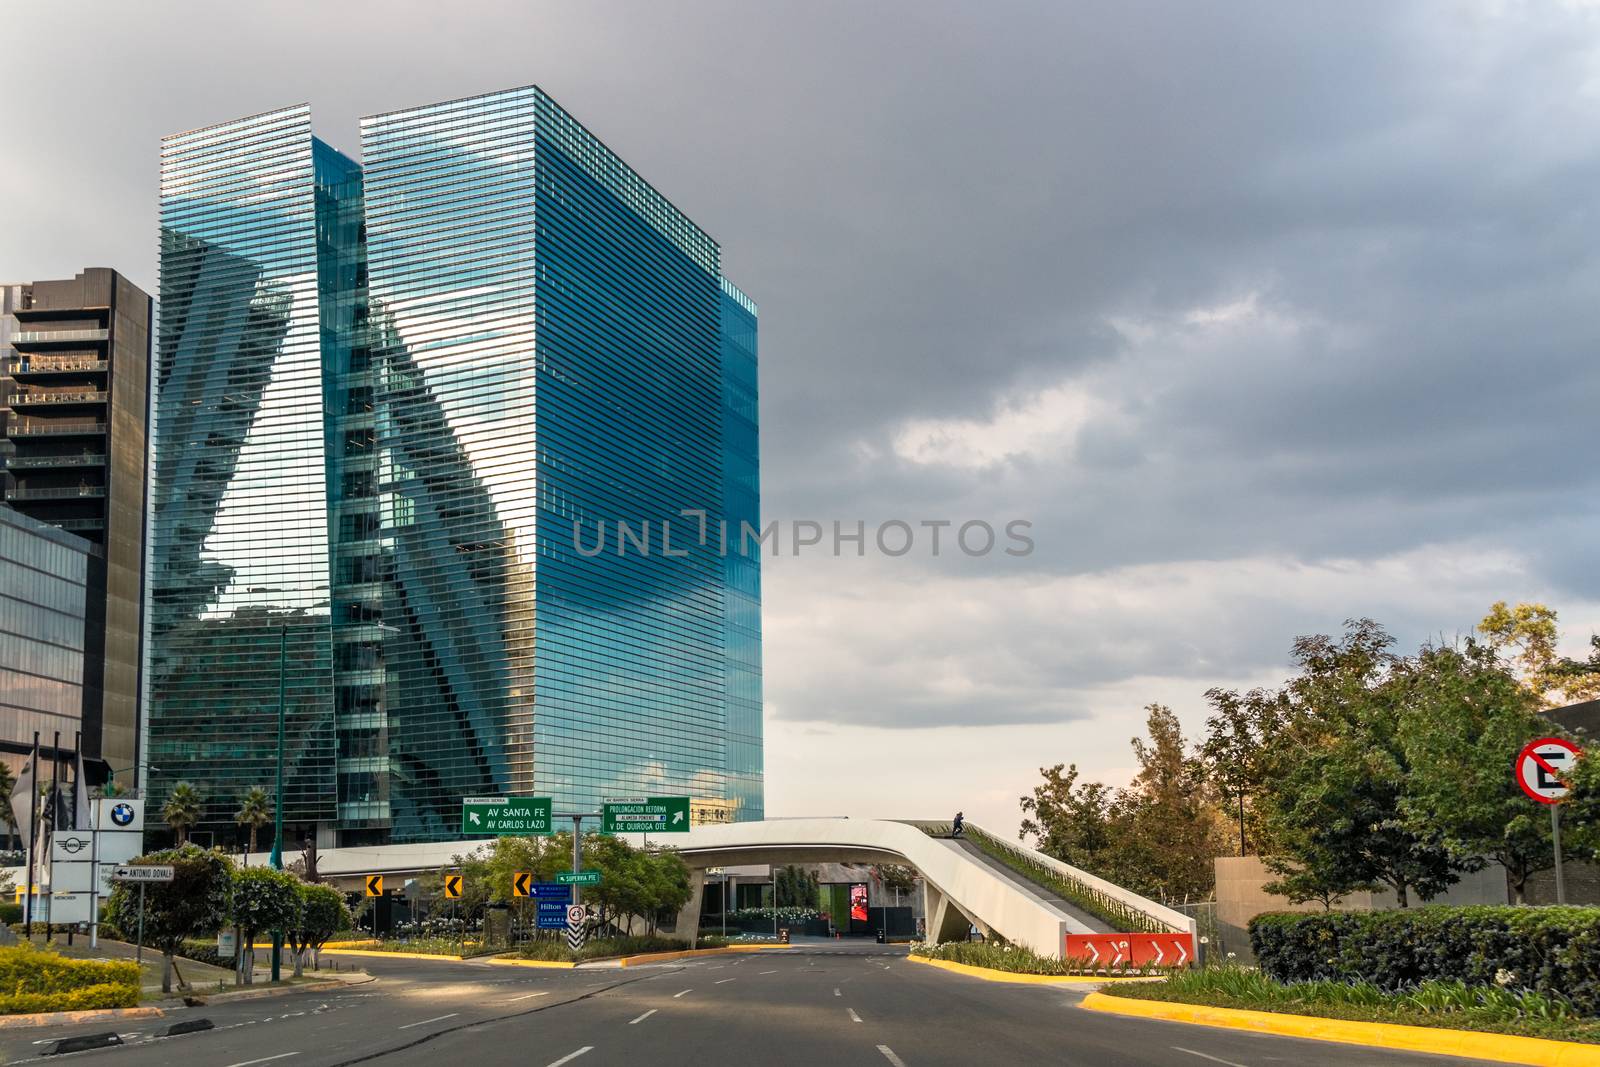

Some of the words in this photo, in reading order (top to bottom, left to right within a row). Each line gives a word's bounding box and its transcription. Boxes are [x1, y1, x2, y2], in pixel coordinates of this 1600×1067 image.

[487, 808, 499, 817] AV
[502, 808, 531, 817] SANTA
[534, 808, 545, 817] FE
[609, 805, 644, 813] PROLONGACION
[646, 805, 667, 813] REFORMA
[486, 820, 496, 829] AV
[497, 820, 524, 829] CARLOS
[526, 820, 545, 829] LAZO
[609, 822, 615, 830] V
[616, 822, 625, 830] DE
[626, 822, 654, 831] QUIROGA
[654, 822, 667, 830] OTE
[129, 868, 151, 878] ANTONIO
